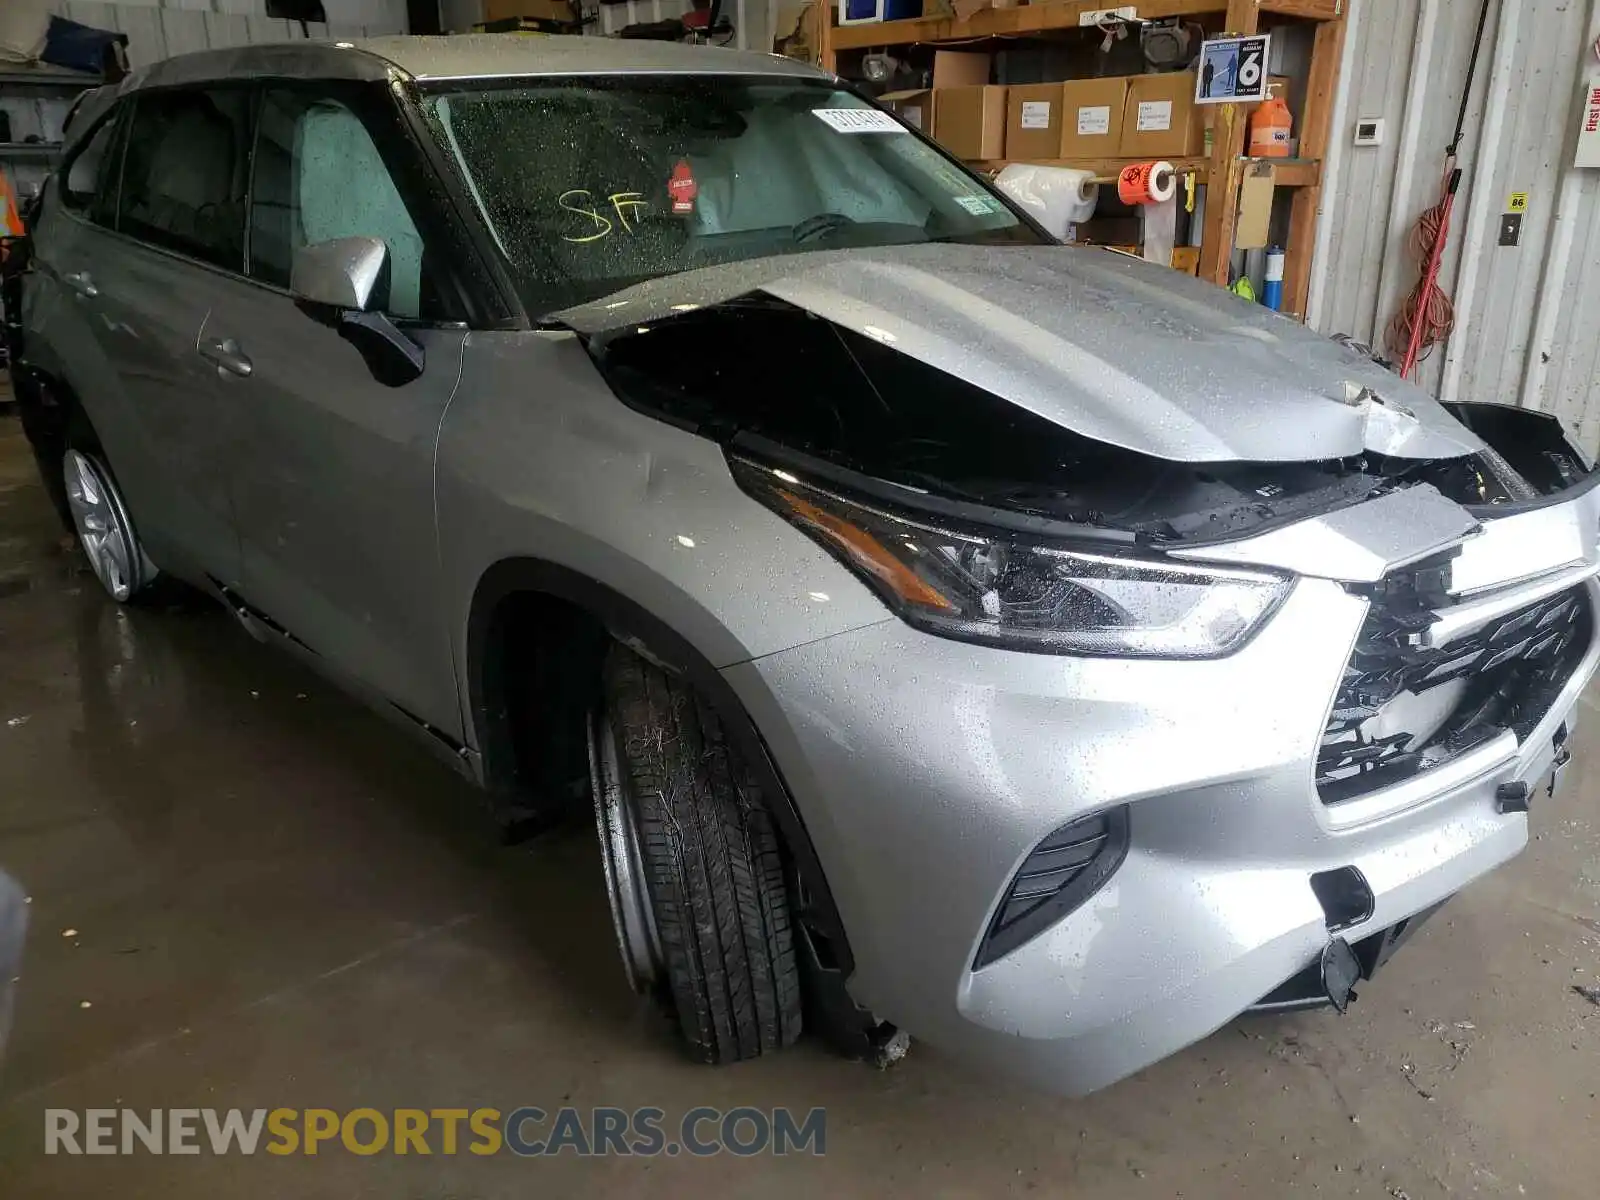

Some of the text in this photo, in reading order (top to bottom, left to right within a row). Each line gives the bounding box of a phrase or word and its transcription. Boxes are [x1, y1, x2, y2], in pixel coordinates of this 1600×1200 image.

[1239, 52, 1260, 86] 6
[1585, 108, 1600, 132] First
[1512, 198, 1524, 207] 86
